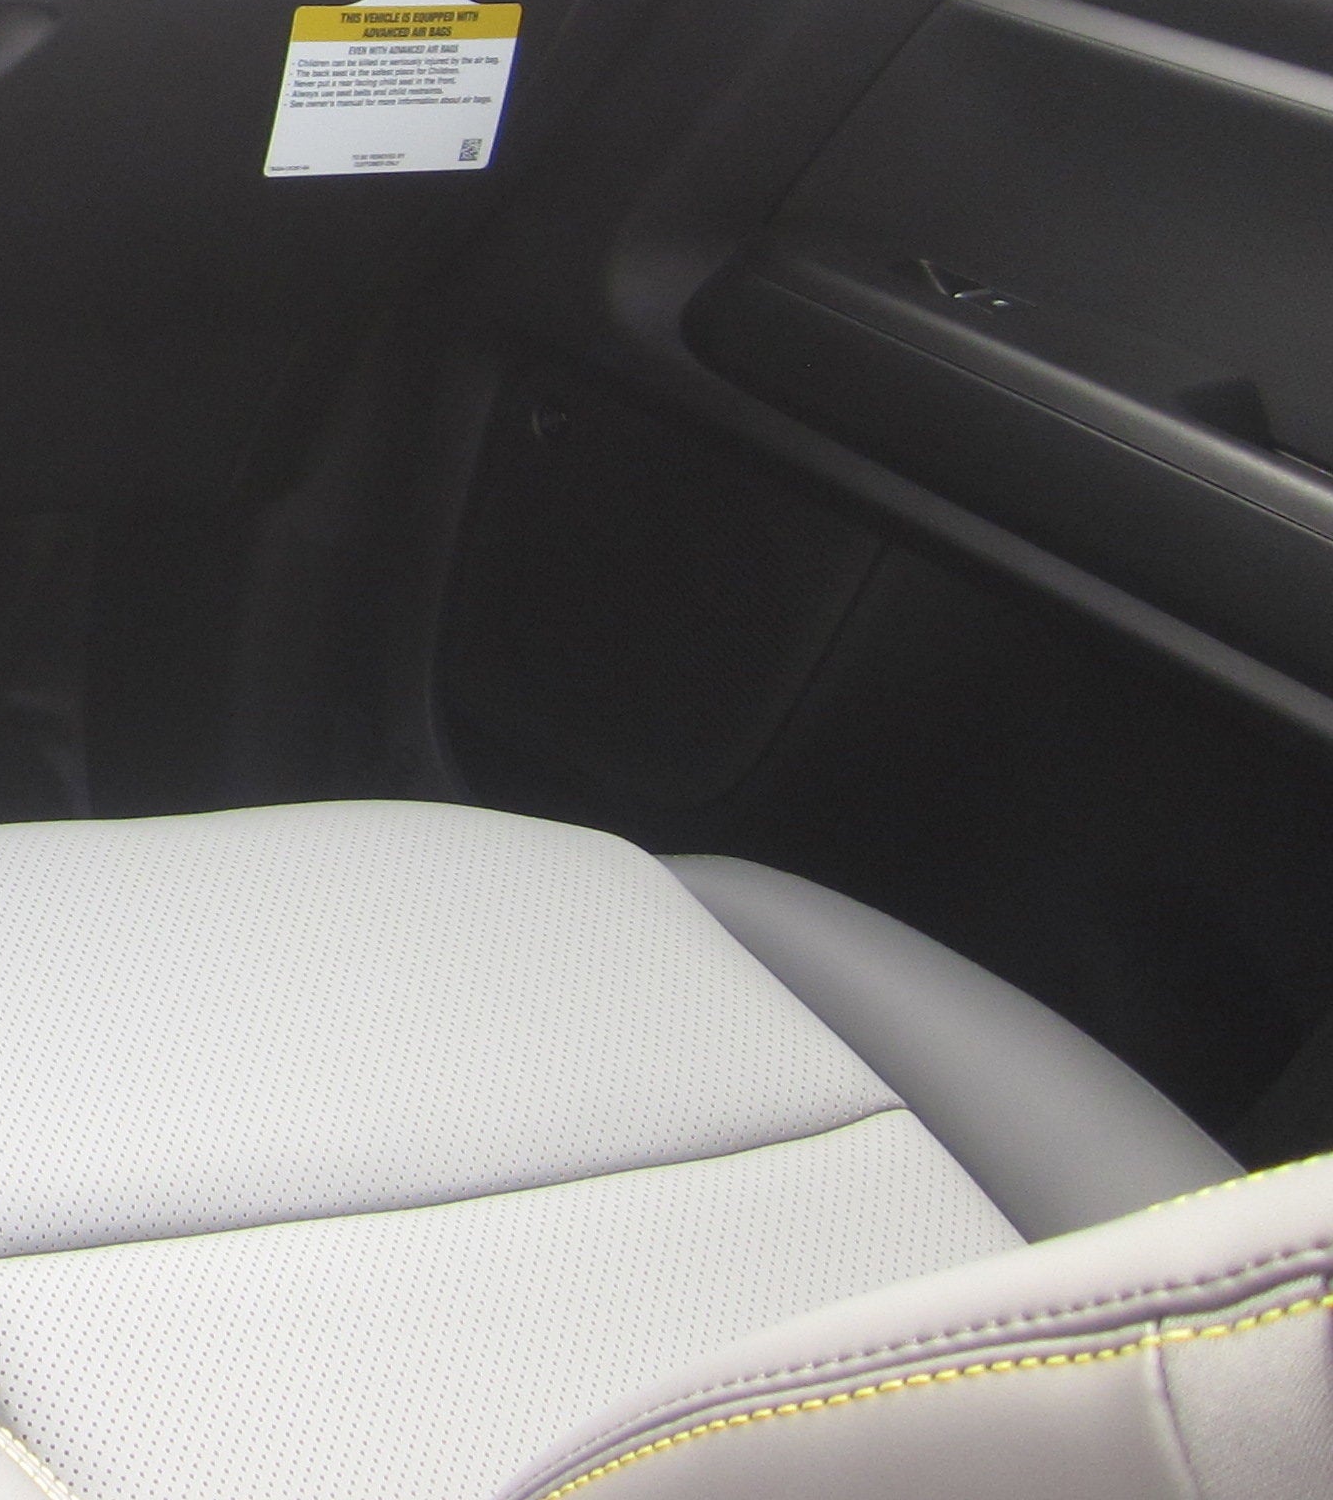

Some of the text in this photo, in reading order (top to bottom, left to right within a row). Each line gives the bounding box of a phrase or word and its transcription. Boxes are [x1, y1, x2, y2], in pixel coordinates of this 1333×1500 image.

[341, 12, 362, 23] THIS
[364, 12, 400, 23] VEHICLE
[412, 11, 455, 22] EQUIPPED
[363, 26, 452, 38] ADVANCED AIR BAGS
